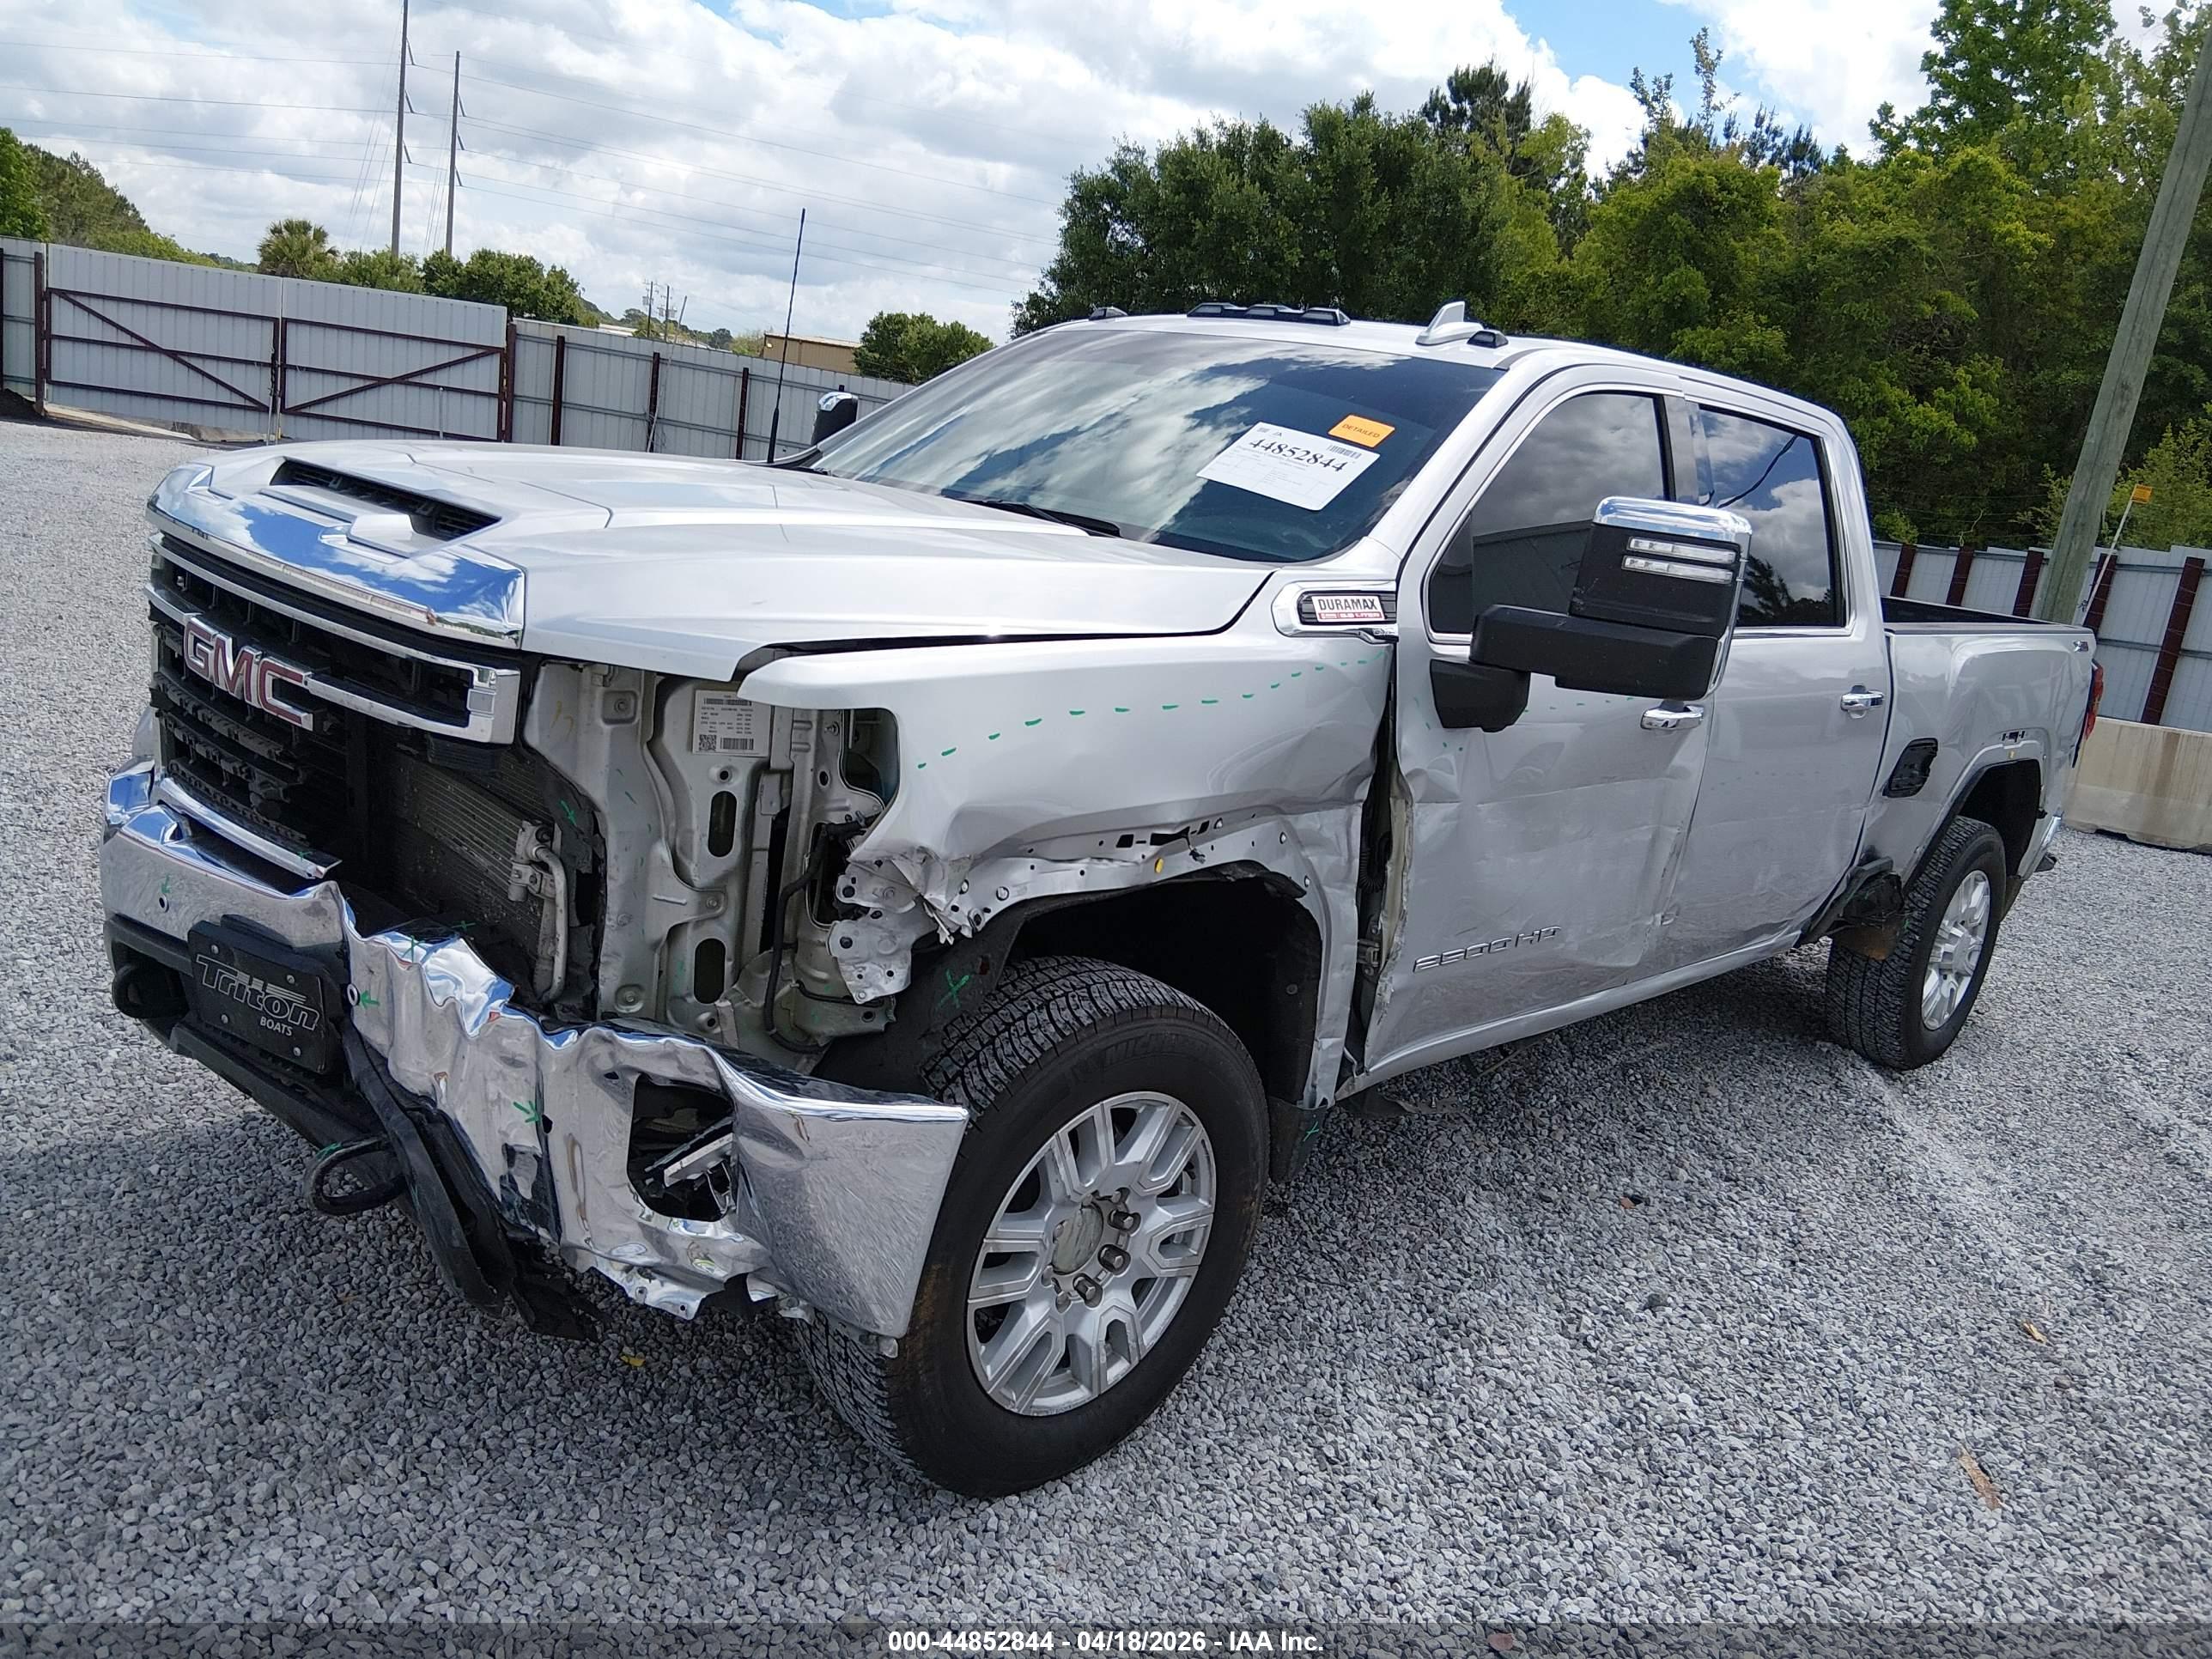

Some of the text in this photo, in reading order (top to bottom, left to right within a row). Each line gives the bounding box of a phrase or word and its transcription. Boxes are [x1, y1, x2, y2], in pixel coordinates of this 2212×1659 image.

[1342, 423, 1380, 439] DETAILED
[1249, 439, 1348, 471] 44852844
[1318, 599, 1378, 611] DURAMAX
[184, 617, 313, 732] GMC
[196, 954, 320, 1031] Triton
[260, 1016, 294, 1037] BOATS
